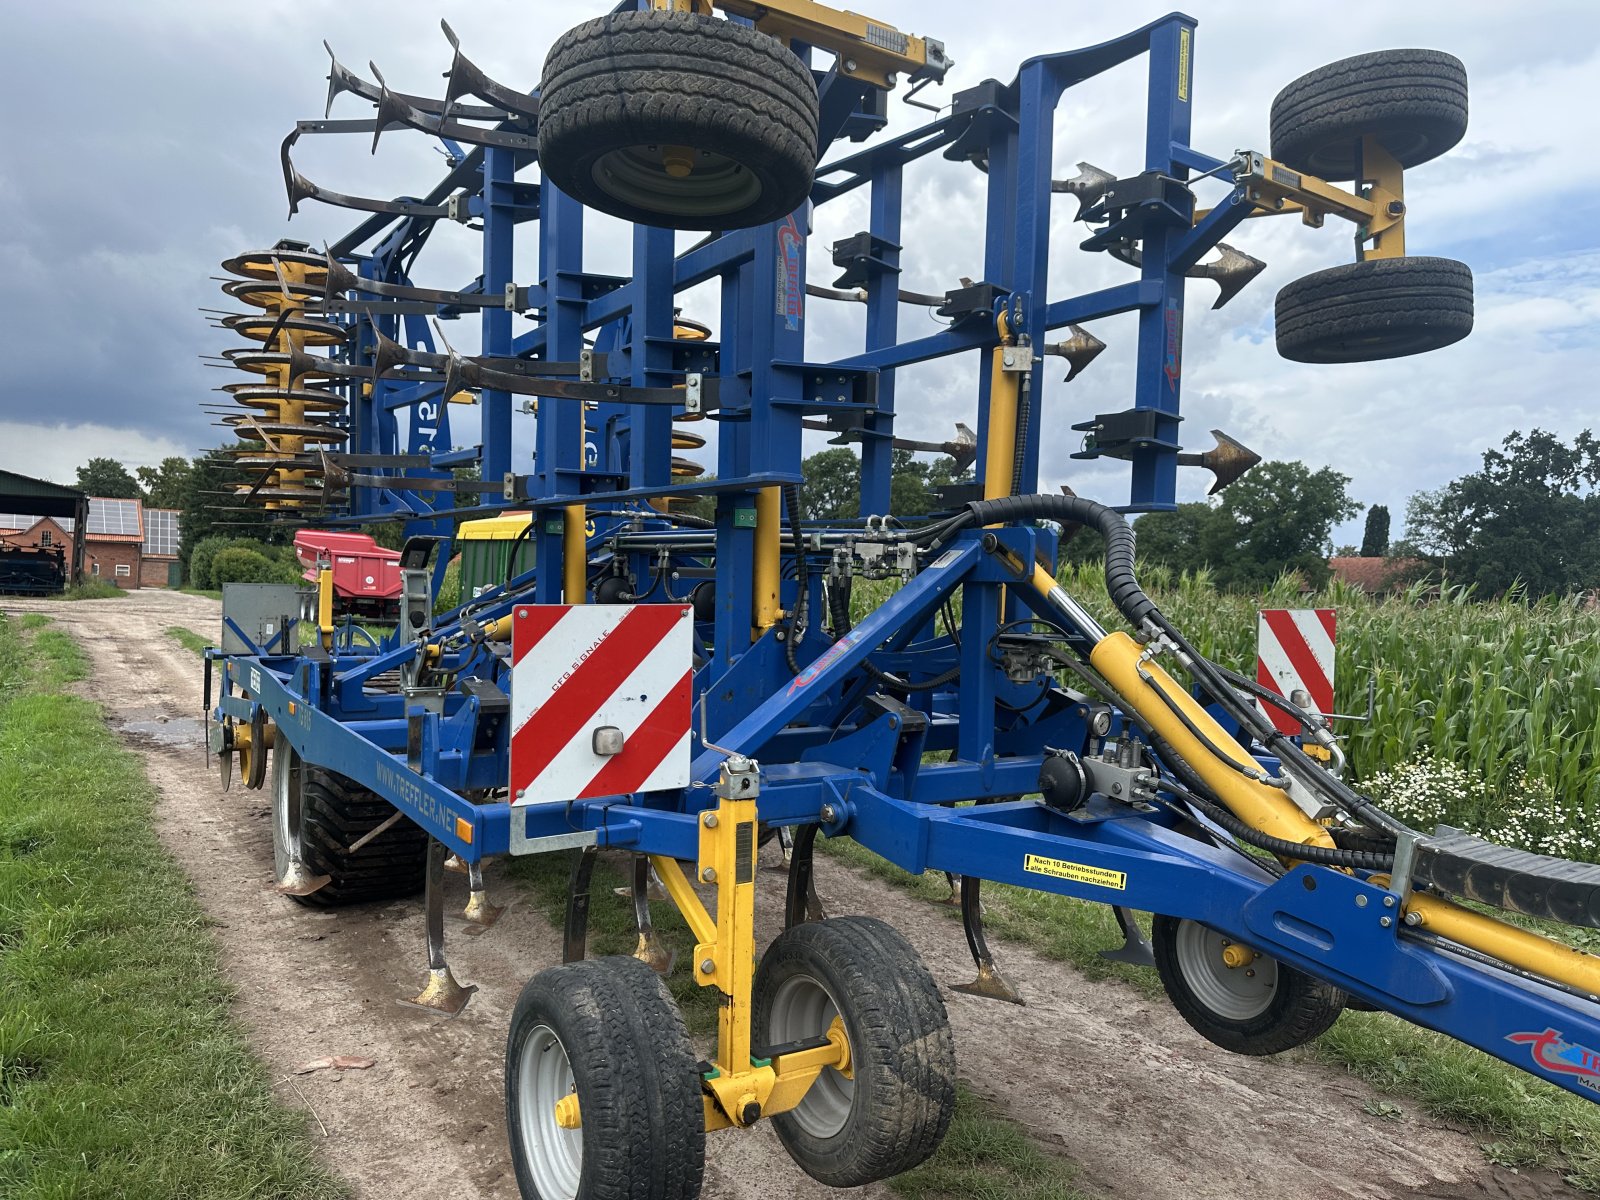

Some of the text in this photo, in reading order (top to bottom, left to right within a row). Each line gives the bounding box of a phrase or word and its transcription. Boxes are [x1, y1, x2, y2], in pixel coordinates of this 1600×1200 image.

[551, 671, 571, 692] CFG
[376, 760, 459, 837] WWW.TREFFLER.NET
[1030, 865, 1119, 888] alle Schrauben nachziehen
[1033, 857, 1117, 879] Nach 10 Betriebsstunden
